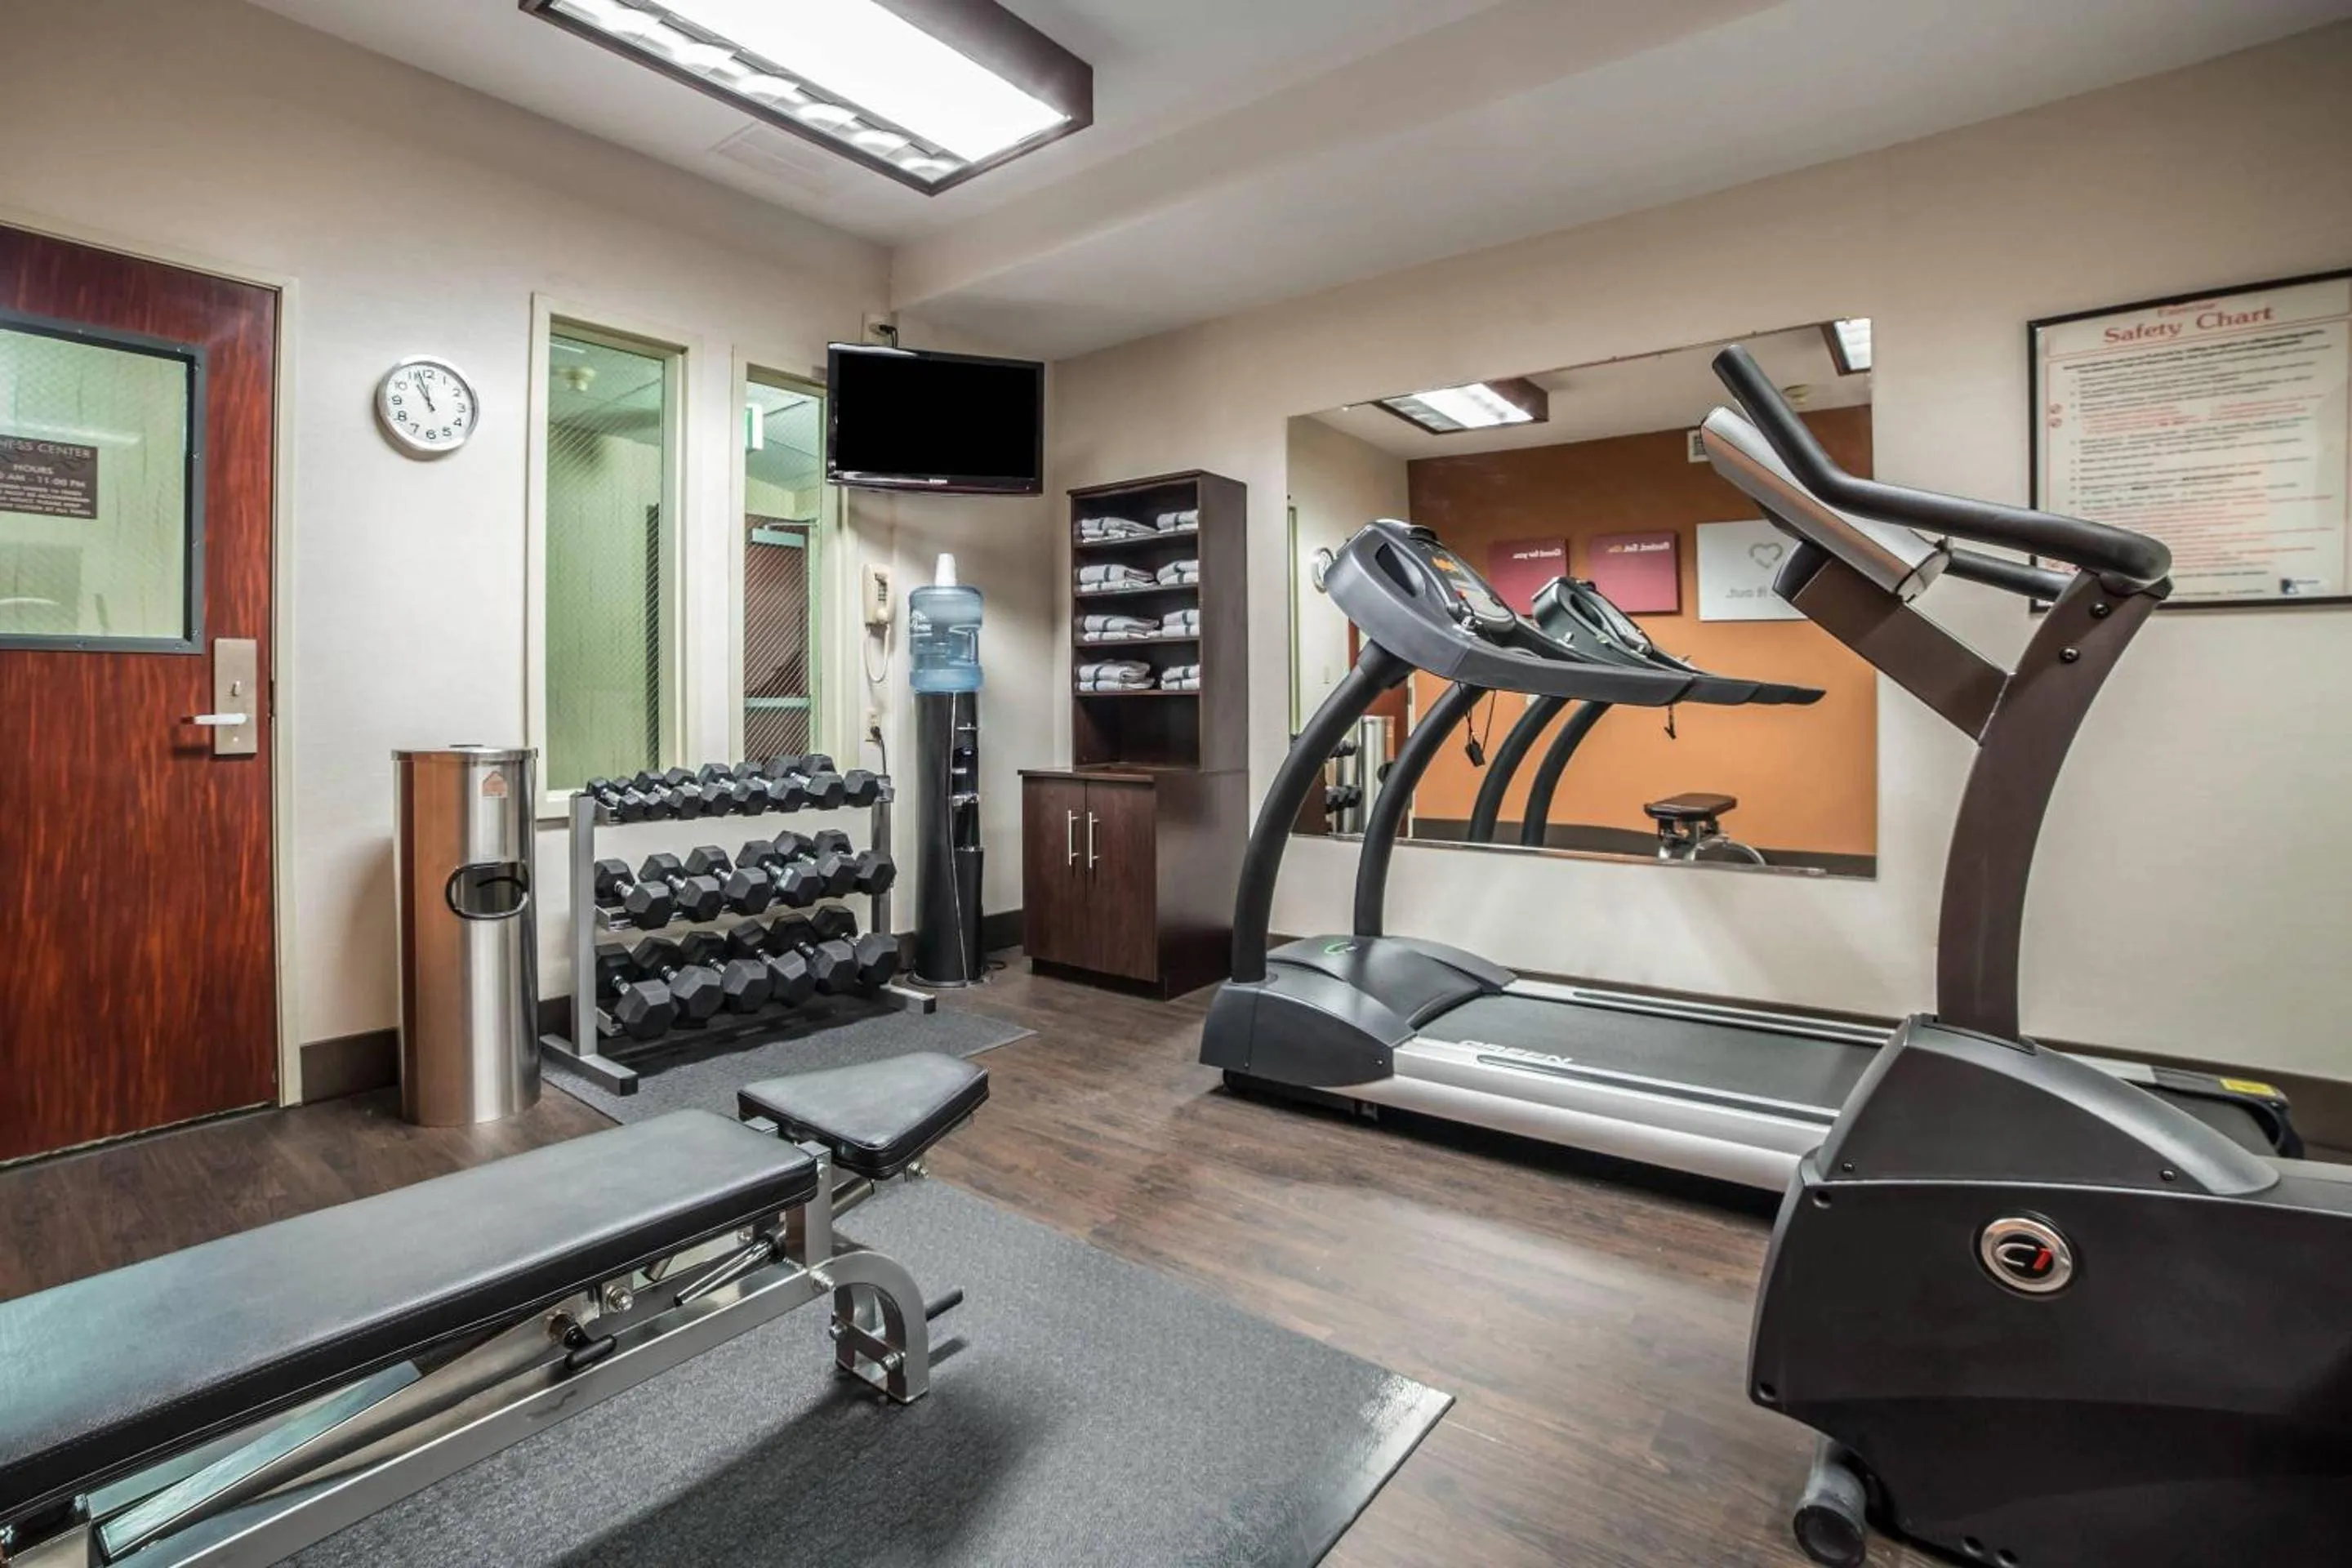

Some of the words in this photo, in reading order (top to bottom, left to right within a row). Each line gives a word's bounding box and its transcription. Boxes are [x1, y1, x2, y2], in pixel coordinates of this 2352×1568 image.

[2103, 319, 2183, 345] Safety
[2195, 305, 2275, 331] Chart
[392, 394, 403, 406] 9
[457, 402, 466, 413] 3
[398, 410, 408, 422] 8
[452, 417, 462, 426] 4
[409, 422, 421, 434] 7
[442, 426, 452, 437] 5
[425, 429, 437, 440] 6
[38, 443, 91, 459] CENTER
[13, 463, 55, 475] HOURS
